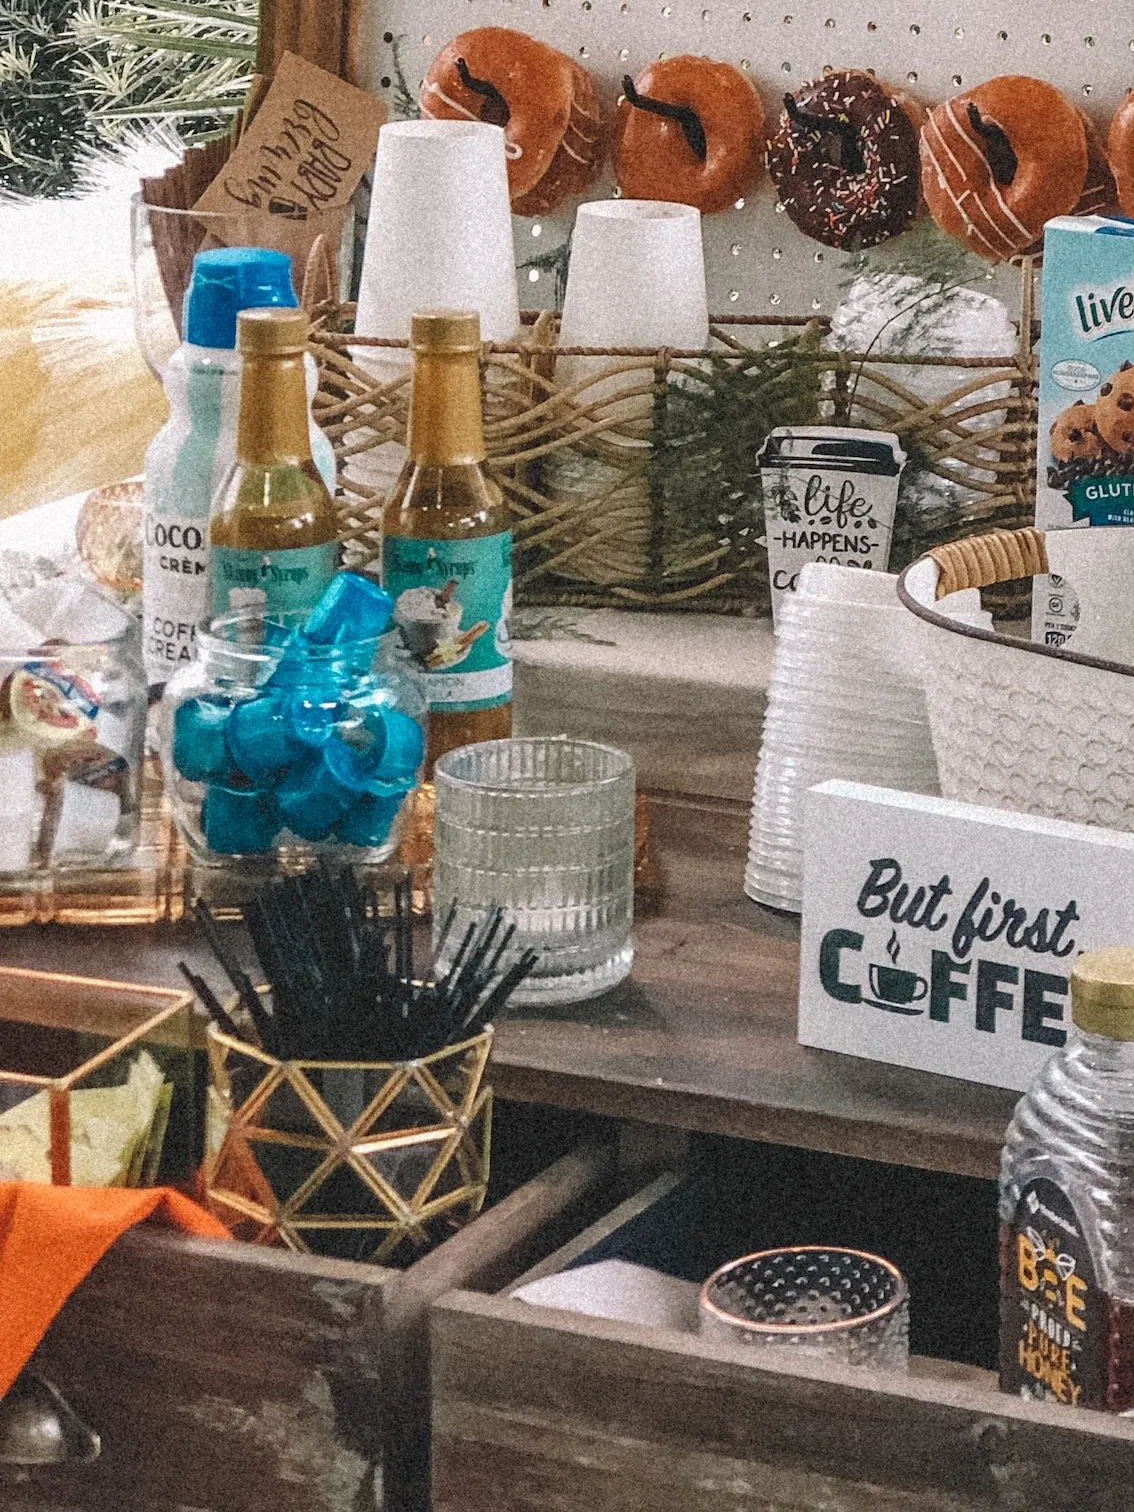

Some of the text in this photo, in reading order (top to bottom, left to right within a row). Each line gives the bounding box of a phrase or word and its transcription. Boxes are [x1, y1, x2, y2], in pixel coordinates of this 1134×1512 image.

[804, 474, 873, 529] life
[145, 513, 205, 551] COCO
[150, 637, 198, 662] CREA
[856, 857, 1084, 959] But first
